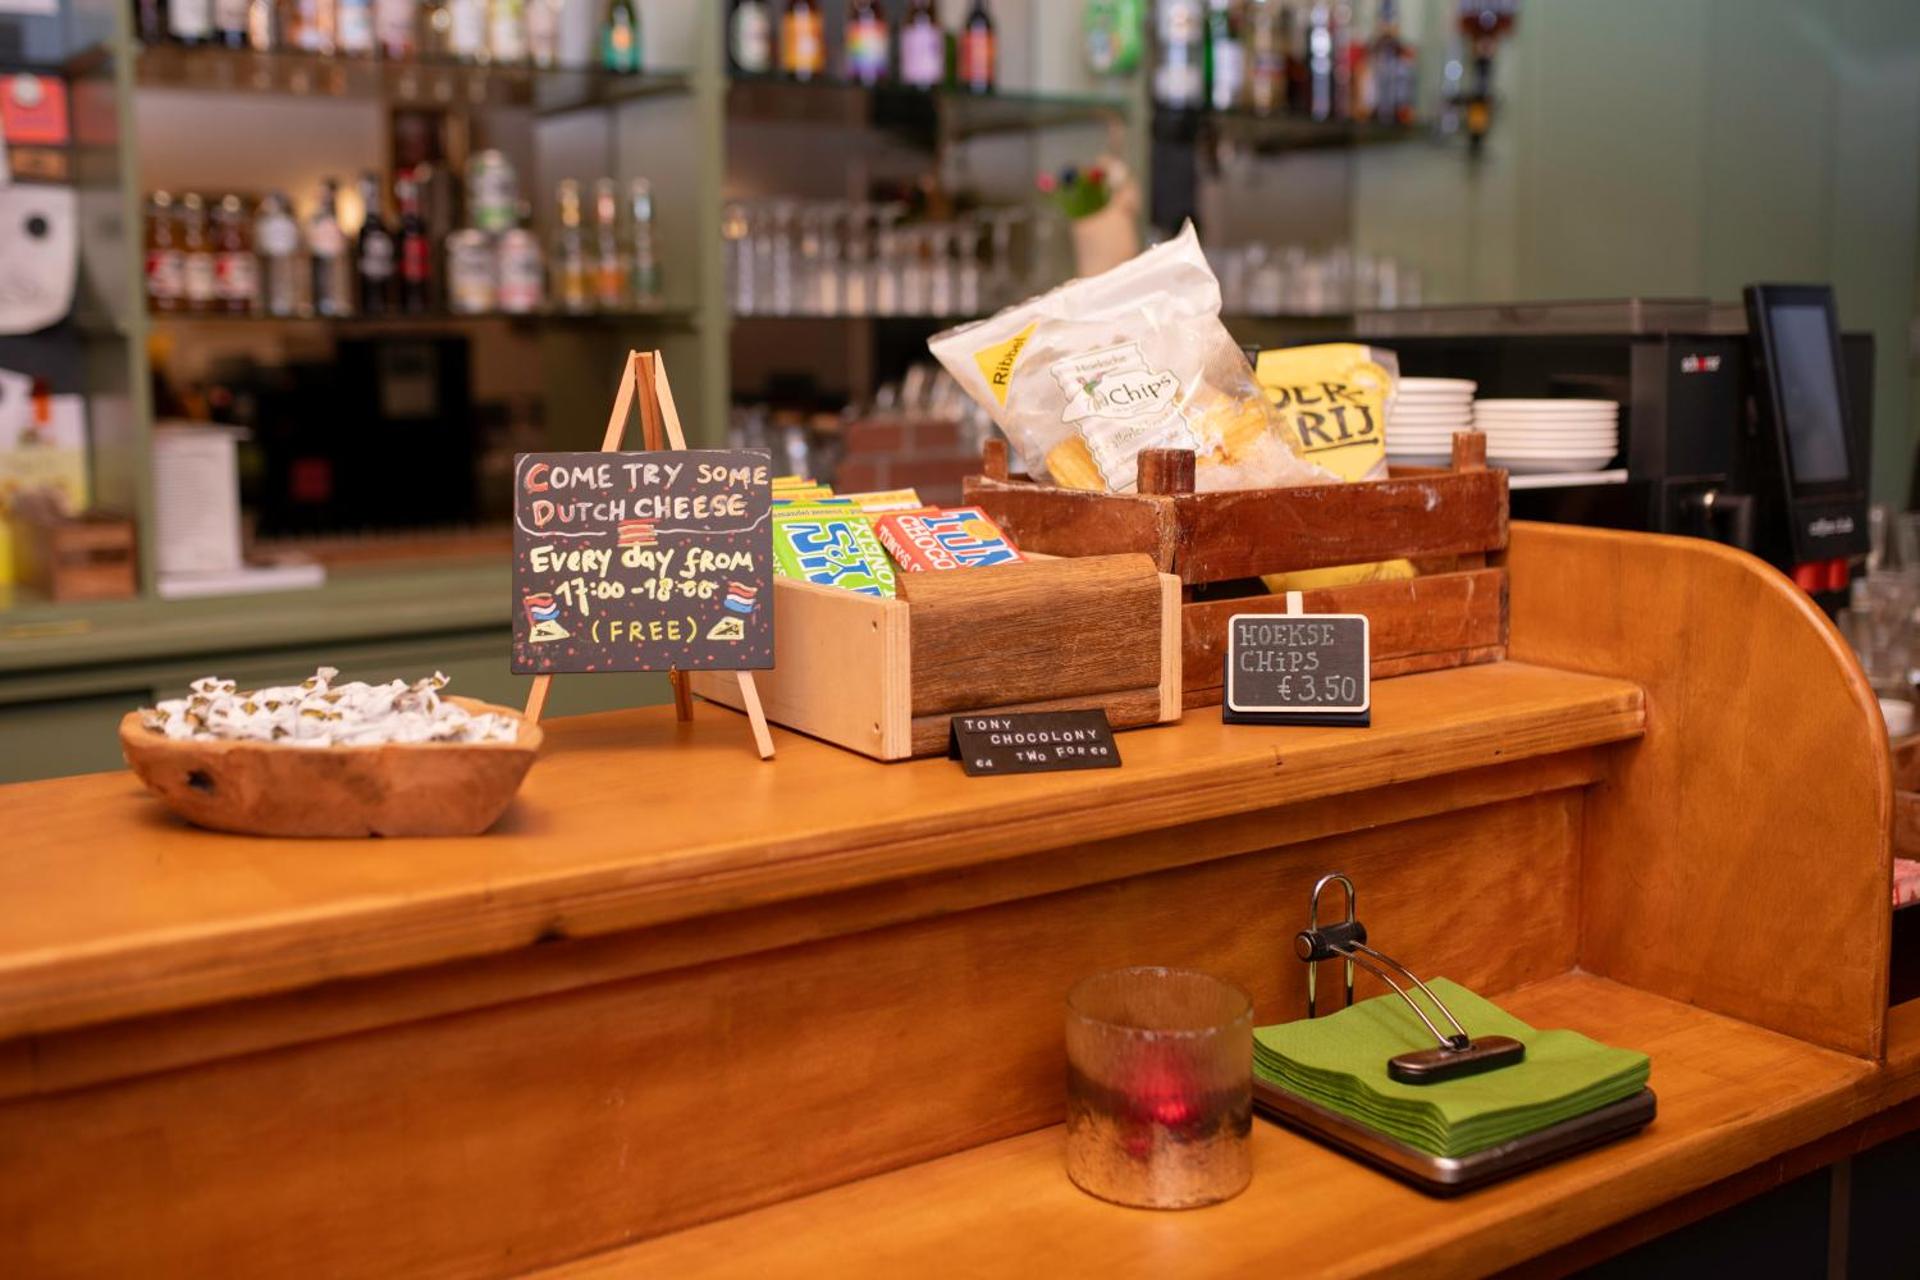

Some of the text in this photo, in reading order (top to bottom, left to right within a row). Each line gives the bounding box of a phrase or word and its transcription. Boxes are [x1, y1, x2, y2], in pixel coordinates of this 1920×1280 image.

[1109, 376, 1171, 405] Chips
[1297, 404, 1374, 447] RIJ
[524, 463, 769, 493] COME TRY SOME
[532, 499, 626, 527] DUTCH
[634, 494, 747, 520] CHEESE
[621, 545, 675, 579] day
[1238, 623, 1335, 647] HOEKSE
[964, 719, 1011, 731] TONY
[990, 729, 1097, 745] CHOCOLONY
[1055, 746, 1085, 758] FOR
